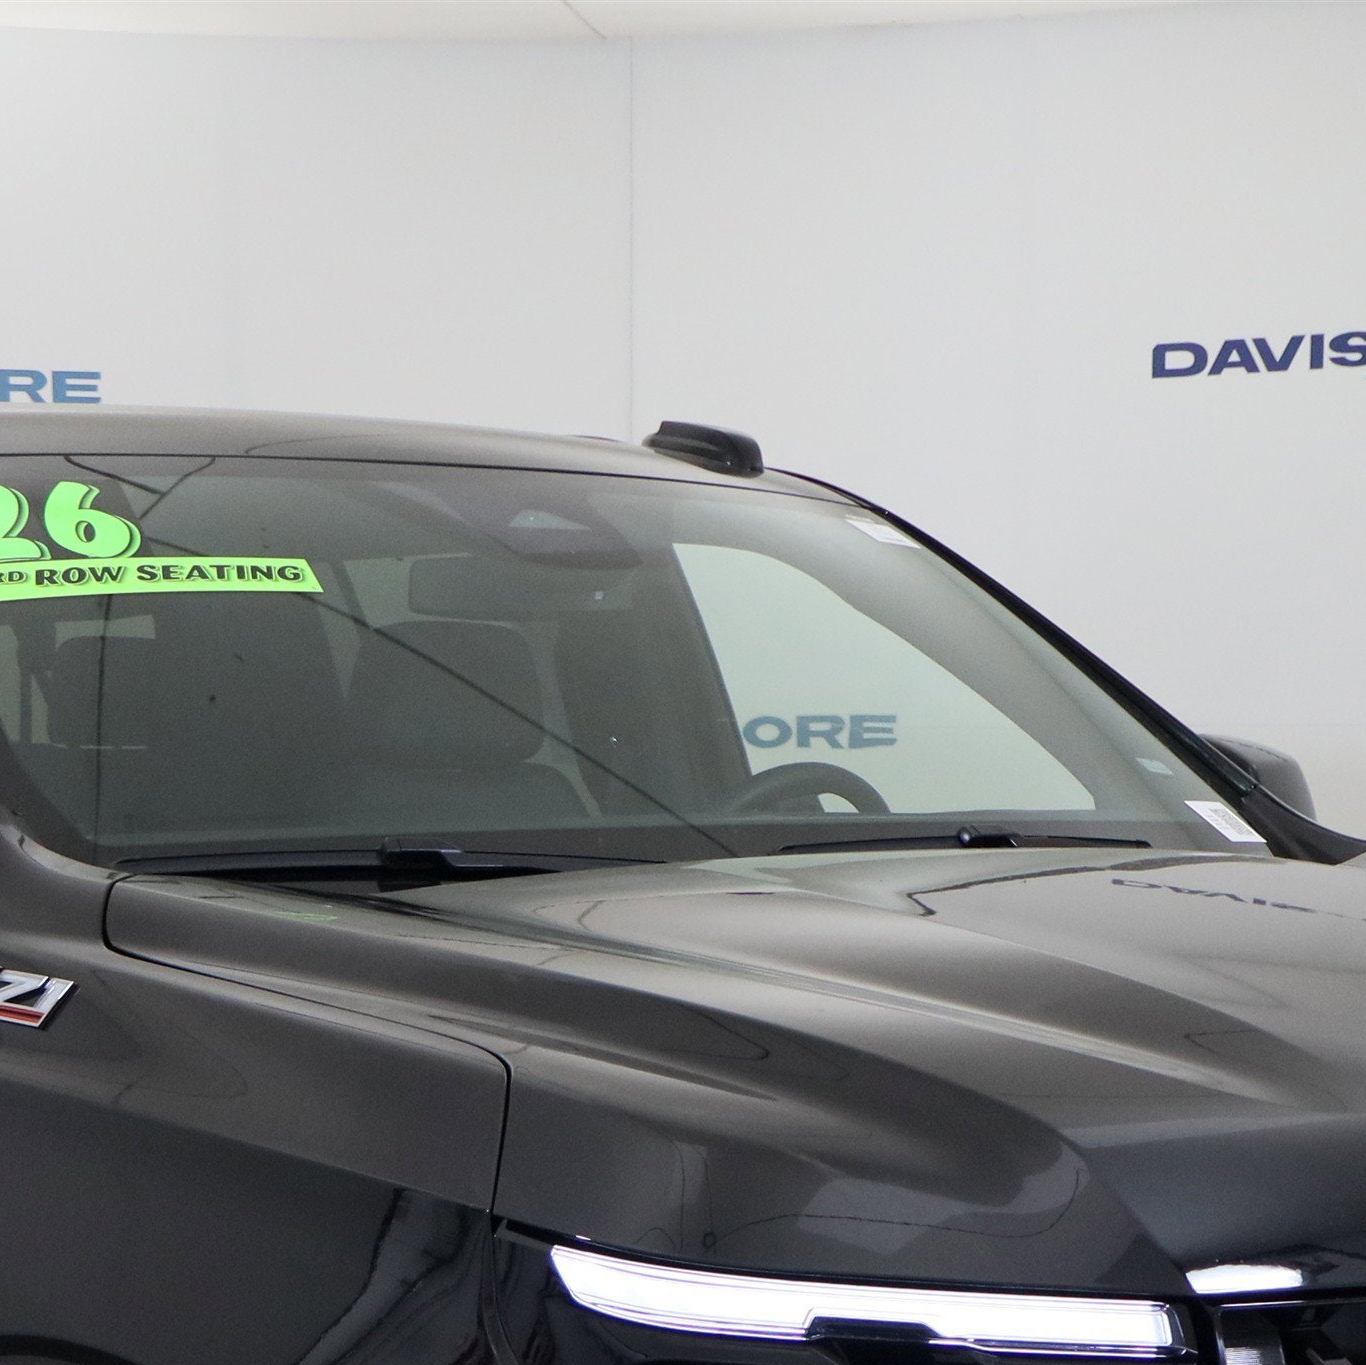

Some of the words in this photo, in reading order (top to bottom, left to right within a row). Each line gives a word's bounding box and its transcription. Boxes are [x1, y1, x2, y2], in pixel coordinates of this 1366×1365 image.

[35, 566, 125, 586] ROW
[137, 564, 304, 583] SEATING
[743, 715, 897, 749] ORE
